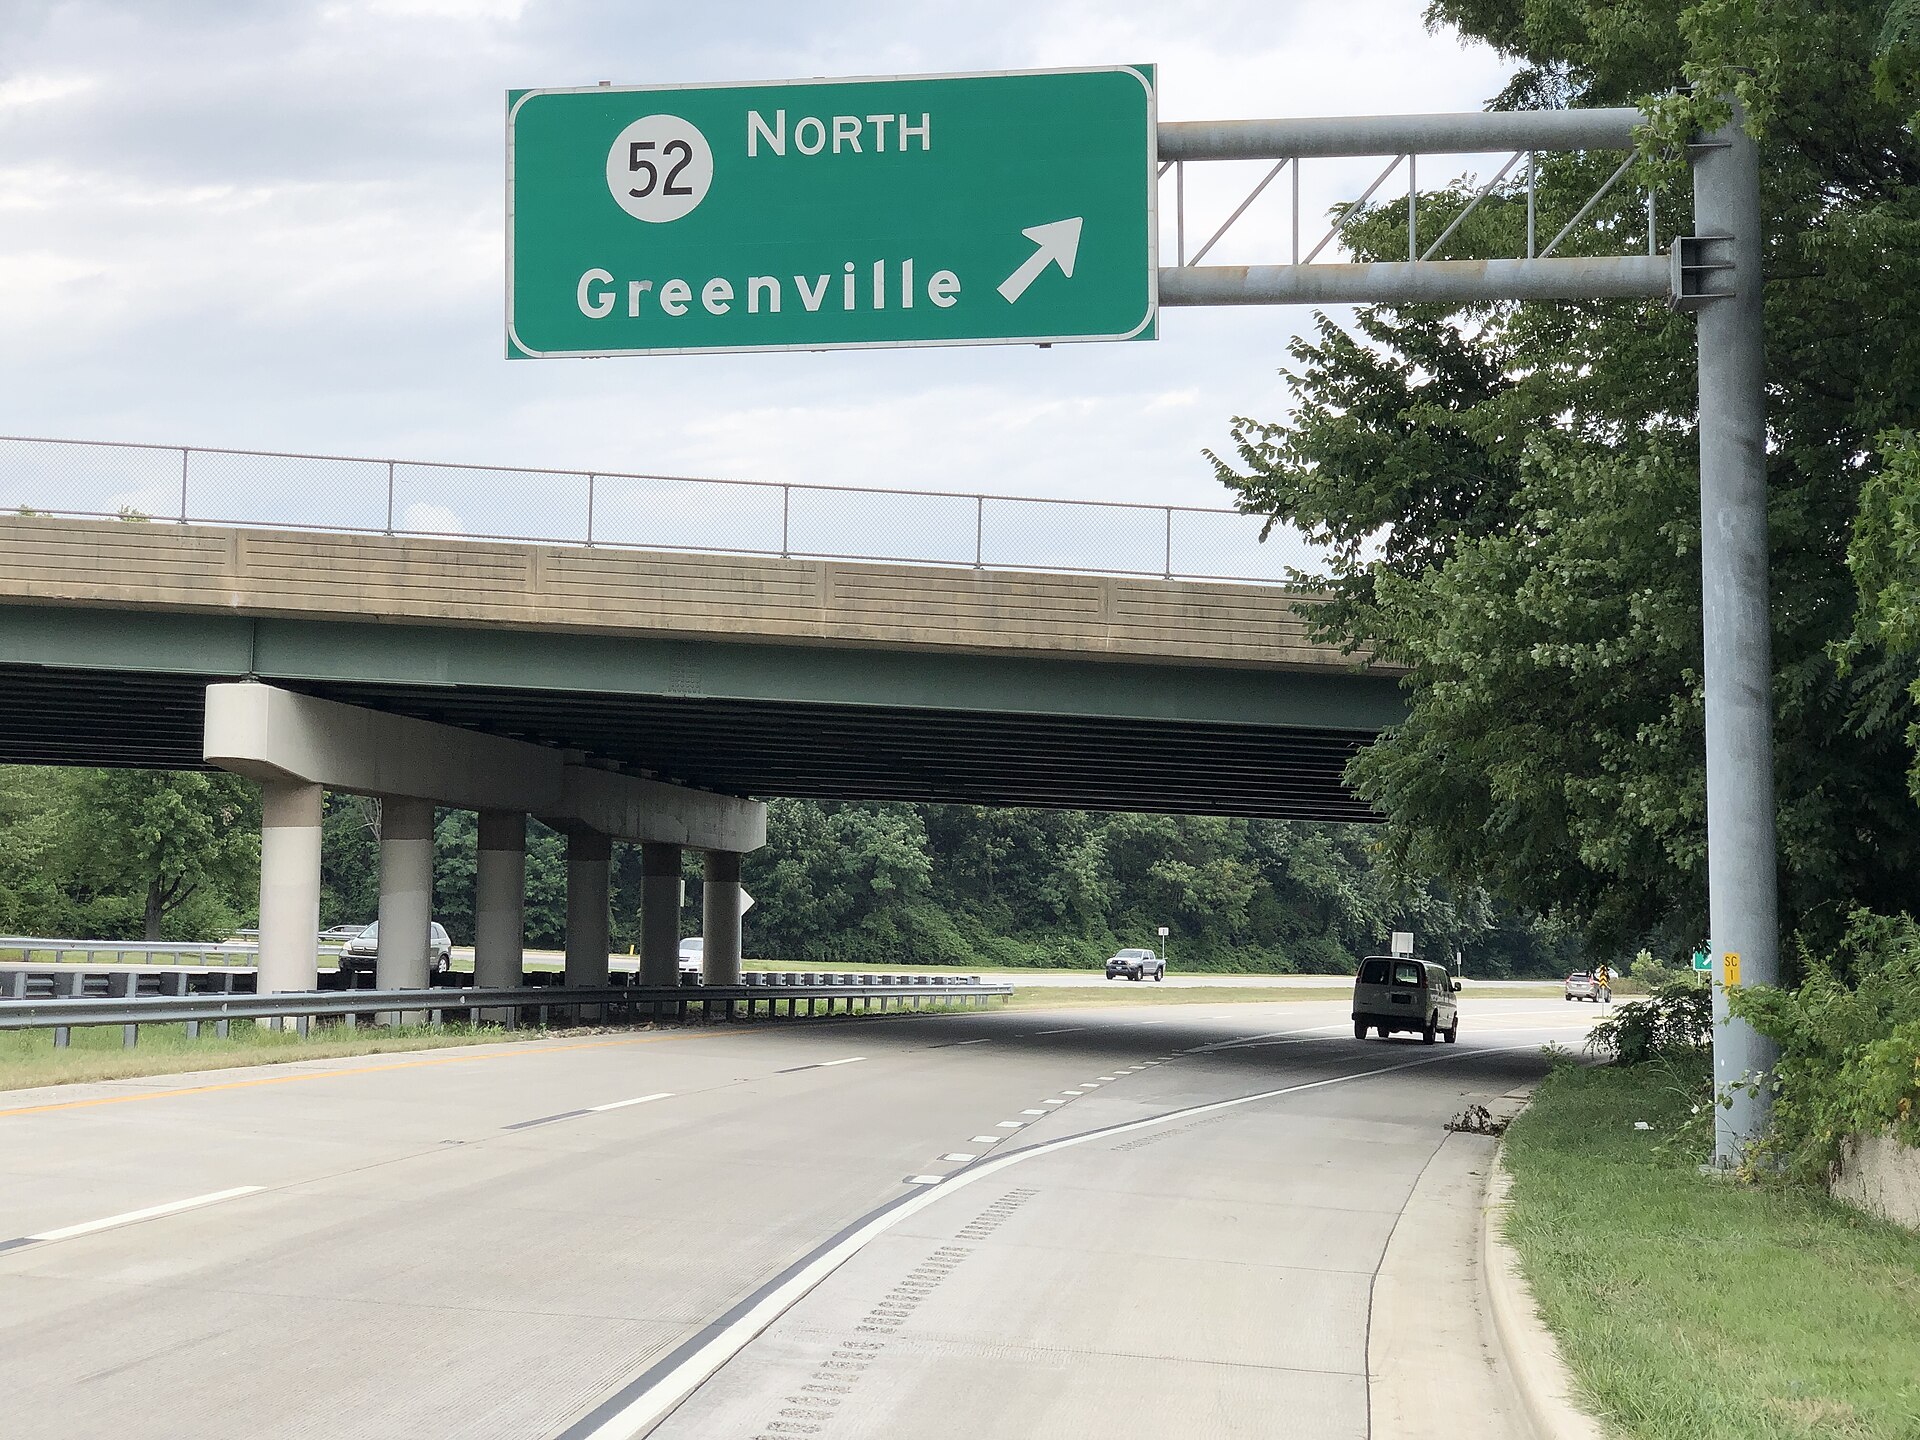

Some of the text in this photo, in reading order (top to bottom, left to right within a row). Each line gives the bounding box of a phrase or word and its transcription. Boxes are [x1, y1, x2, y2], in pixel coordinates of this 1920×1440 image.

[747, 109, 931, 158] NORTH
[628, 139, 693, 198] 52
[576, 257, 962, 318] Greenville
[1725, 956, 1738, 967] SC
